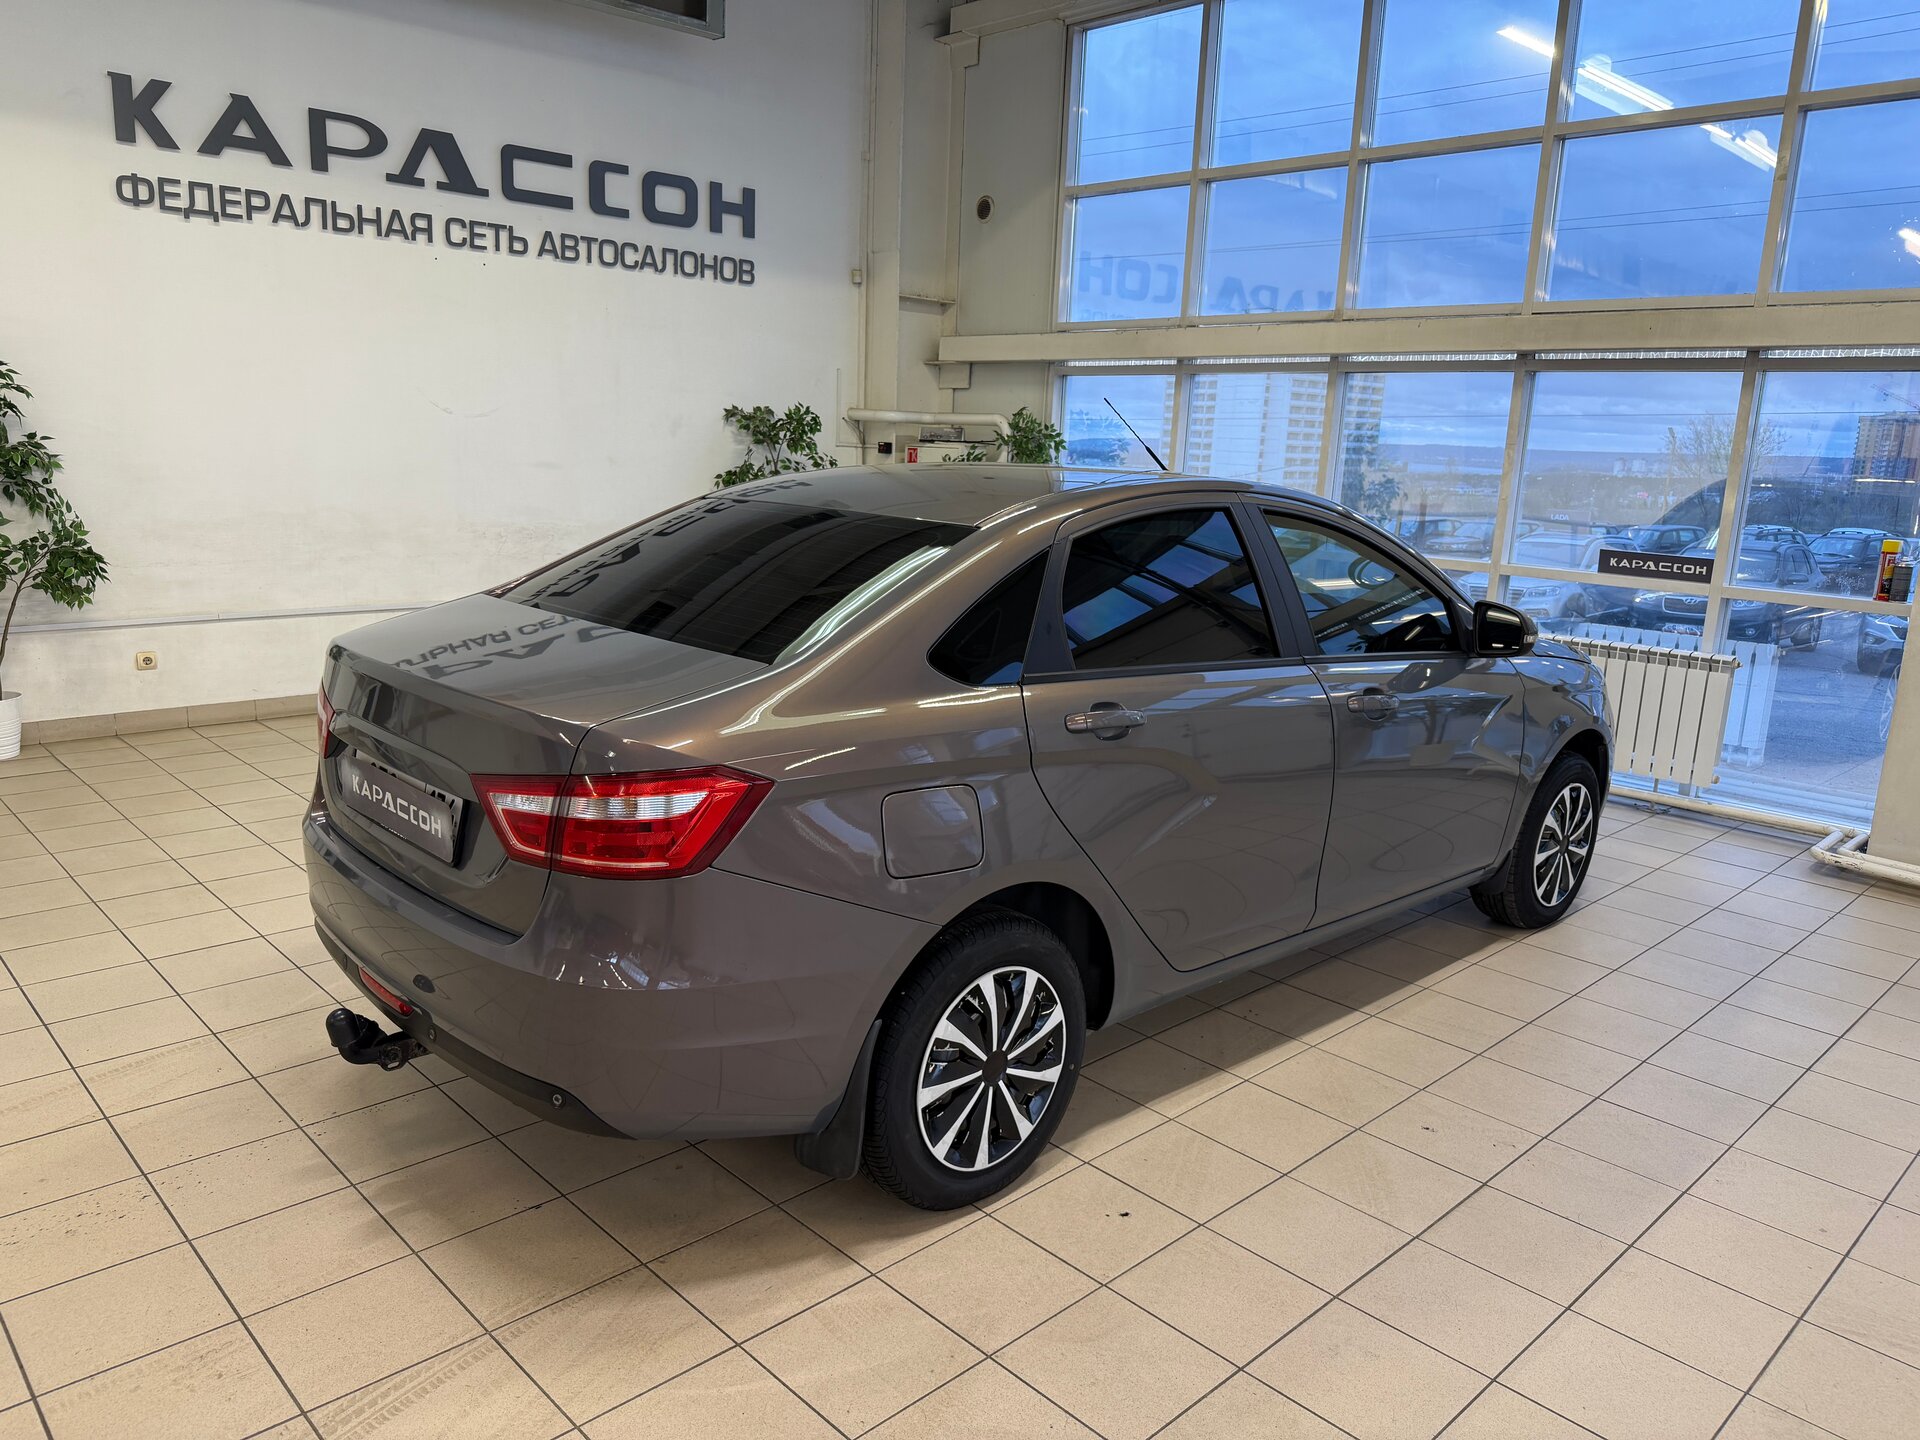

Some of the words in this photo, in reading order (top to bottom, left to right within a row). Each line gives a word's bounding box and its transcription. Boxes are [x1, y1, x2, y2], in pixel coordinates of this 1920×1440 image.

[107, 71, 755, 239] КАРАССОН
[115, 173, 434, 244] ФЕДЕРАЛЬНАЯ
[445, 217, 529, 256] СЕТЬ
[538, 231, 755, 285] АВТОСАЛОНОВ
[1610, 557, 1707, 575] КАРАССОН
